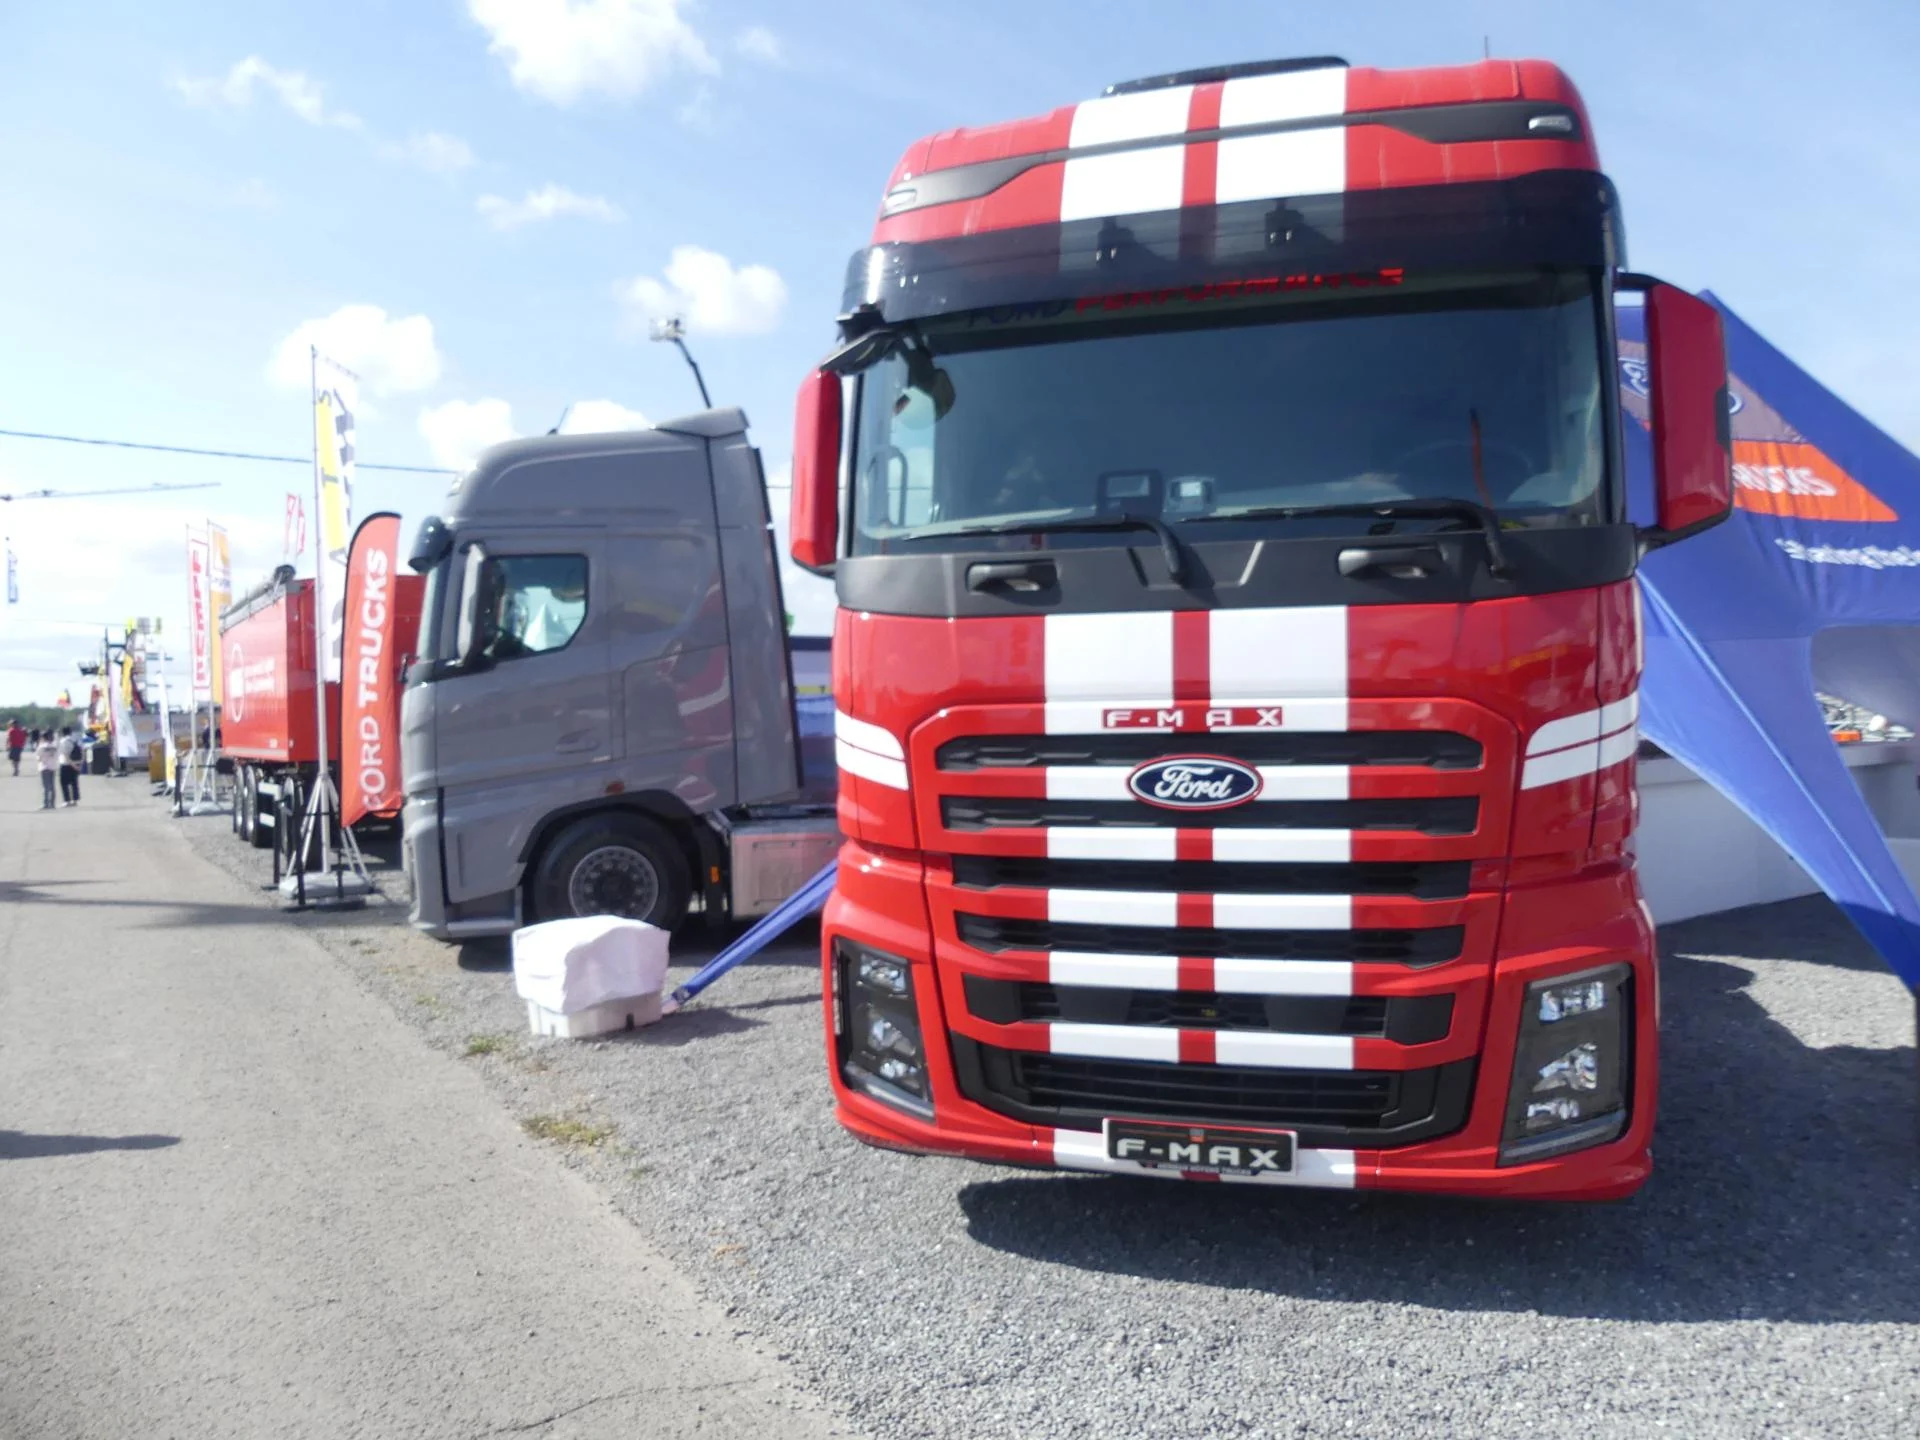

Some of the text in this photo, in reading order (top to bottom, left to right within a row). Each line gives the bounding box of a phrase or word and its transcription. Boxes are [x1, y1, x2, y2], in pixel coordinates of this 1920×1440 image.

[358, 547, 389, 709] TRUCKS
[1106, 708, 1281, 728] F-MAX
[1154, 765, 1235, 799] Ford
[1116, 1138, 1279, 1170] F-MAX
